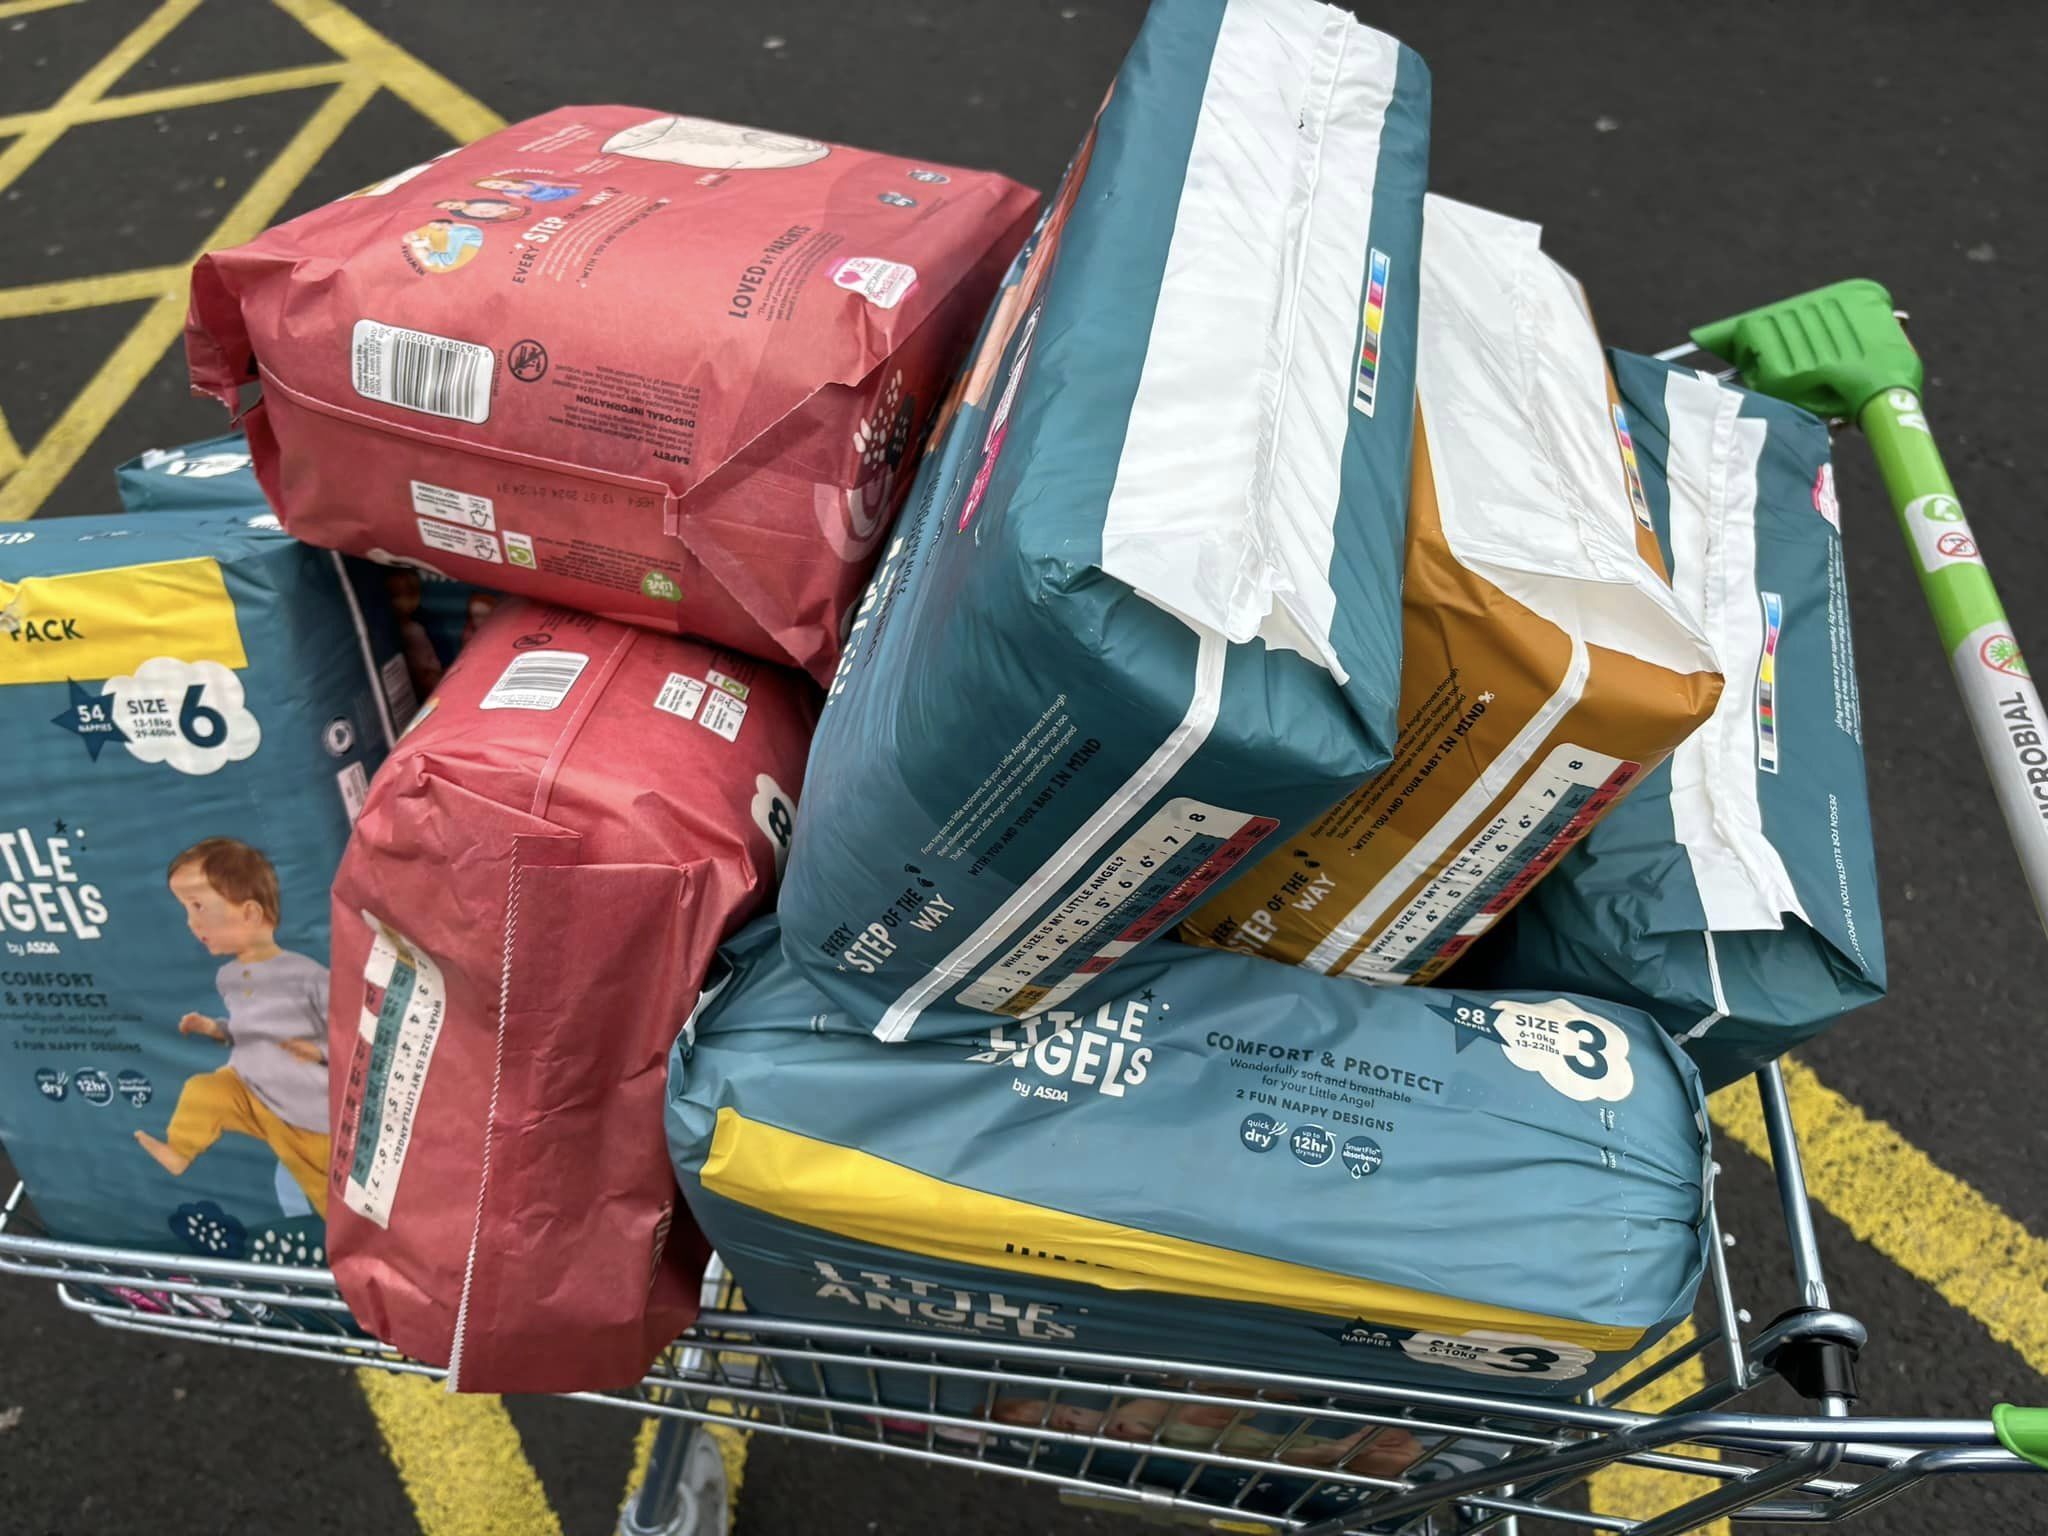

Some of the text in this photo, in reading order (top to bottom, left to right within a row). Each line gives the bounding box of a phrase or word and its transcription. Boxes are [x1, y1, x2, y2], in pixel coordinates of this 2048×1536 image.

[522, 217, 569, 244] STEP
[512, 245, 540, 283] EVERY
[728, 264, 767, 319] LOVED
[765, 225, 812, 260] PARENTS
[576, 394, 696, 428] DISPOSAL INFORMATION
[652, 450, 689, 465] SAFETY
[77, 705, 105, 723] 54
[1406, 668, 1458, 730] Angel moves through
[127, 684, 228, 748] SIZE 6
[999, 694, 1066, 769] Little Angel moves through
[1415, 696, 1451, 736] needs change
[1022, 726, 1059, 765] needs change
[1380, 721, 1444, 793] Angels range specifically
[1999, 691, 2048, 820] CROBIAL
[990, 724, 1077, 819] Angels range specifically designed
[1353, 703, 1486, 850] WITH YOU AND YOUR BABY IN MIND
[968, 739, 1101, 876] WITH YOU AND YOUR BABY IN MIND
[1829, 793, 1840, 827] DESIGN
[1404, 935, 1417, 945] 4
[1447, 890, 1461, 900] 5
[1495, 843, 1508, 853] 6
[1543, 789, 1557, 799] 7
[1568, 760, 1583, 770] 8
[1831, 828, 1841, 846] FOR
[0, 828, 78, 882] TLE
[1281, 871, 1309, 896] THE
[1292, 872, 1337, 912] WAY
[1371, 818, 1508, 955] WHAT SIZE IS MY LITTLE ANGEL?
[1833, 846, 1850, 907] ILLUSTRATION
[0, 882, 108, 940] GELS
[998, 986, 1012, 994] 2
[1017, 969, 1031, 977] 3
[1035, 953, 1050, 962] 4
[1074, 918, 1090, 927] 5
[1118, 879, 1133, 889] 6
[1163, 836, 1179, 845] 7
[1189, 813, 1206, 822] 8
[1001, 856, 1127, 968] WHAT SIZE IS MY LITTLE ANGEL?
[1267, 894, 1286, 912] OF
[820, 888, 955, 974] EVERY STEP OF THE WAY
[1211, 916, 1239, 941] VERY
[6, 941, 60, 956] by ASDA
[409, 1014, 420, 1025] 4
[427, 1000, 442, 1030] WHAT
[1454, 1017, 1492, 1034] NAPPIES
[1456, 1007, 1486, 1025] 98
[418, 1033, 434, 1058] SIZE
[1515, 1014, 1609, 1080] SIZE 3
[1515, 1039, 1560, 1055] 13-22lbs
[1519, 1030, 1556, 1046] 6-10kg
[394, 1072, 404, 1082] 5
[415, 1060, 426, 1071] IS
[1206, 1031, 1444, 1095] COMFORT & PROTECT
[42, 1081, 63, 1097] dry
[411, 1072, 422, 1088] MY
[1012, 1078, 1069, 1102] by ASDA
[1230, 1057, 1412, 1103] Wonderfully soft and breathable
[1261, 1074, 1375, 1109] for your Little Angel
[401, 1090, 417, 1123] LITTLE
[1236, 1088, 1395, 1132] 2 FUN NAPPY DESIGNS
[385, 1123, 394, 1134] 6
[1244, 1128, 1271, 1147] dry
[1247, 1119, 1270, 1130] quick
[1293, 1135, 1328, 1153] 12hr
[1295, 1148, 1322, 1159] dryness
[1343, 1150, 1381, 1165] absorbency
[372, 1178, 380, 1188] 7
[1341, 1332, 1392, 1348] NAPPIES
[1487, 1346, 1560, 1373] 3
